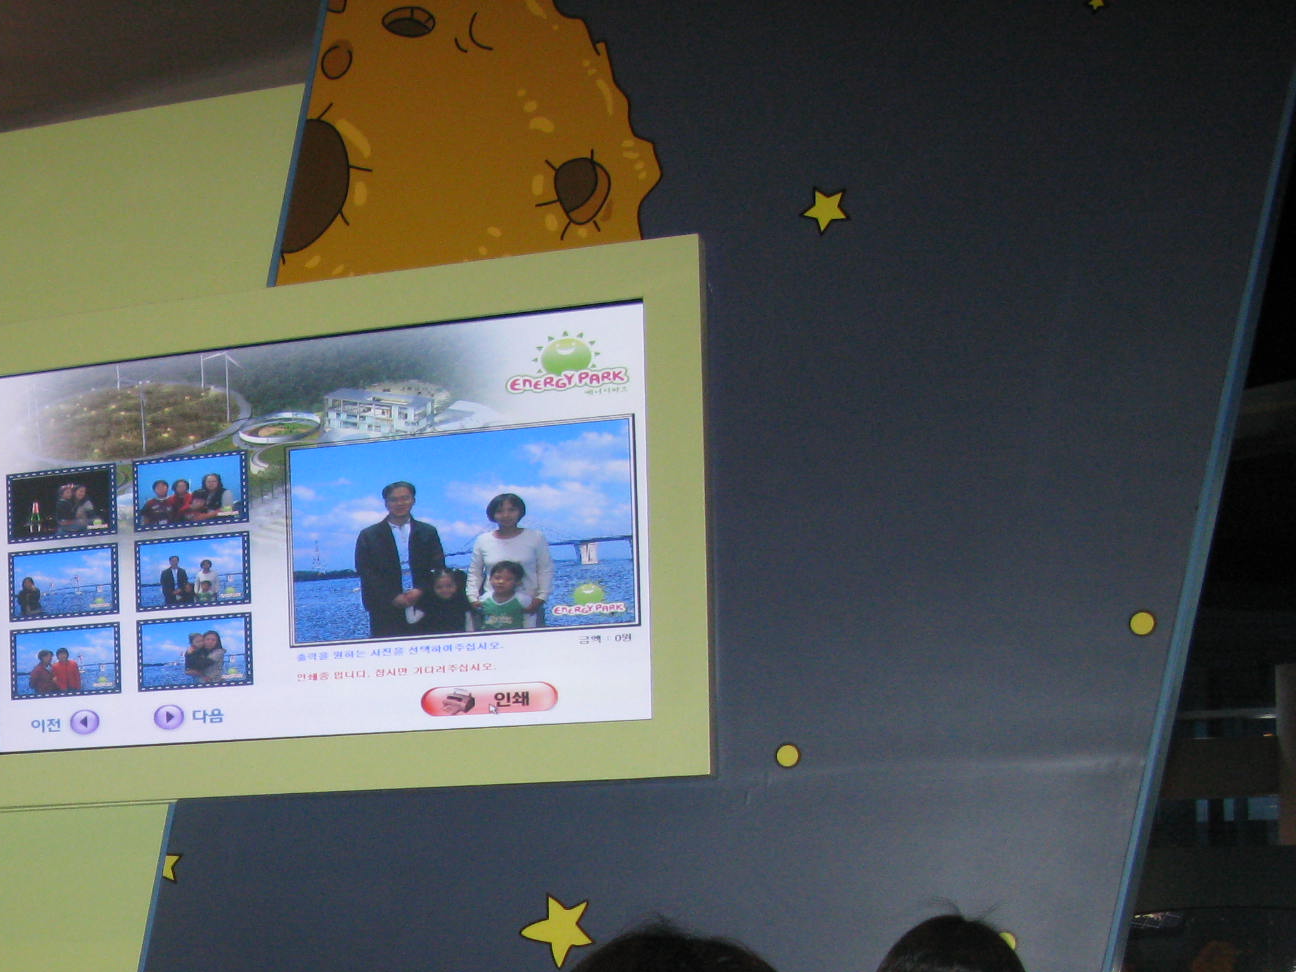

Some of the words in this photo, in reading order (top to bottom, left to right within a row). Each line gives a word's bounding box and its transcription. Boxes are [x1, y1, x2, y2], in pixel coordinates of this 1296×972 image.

[578, 370, 625, 385] PARK
[595, 603, 624, 612] PARK
[494, 690, 530, 708] 인쇄
[192, 708, 225, 724] 다음
[31, 718, 61, 733] 이전
